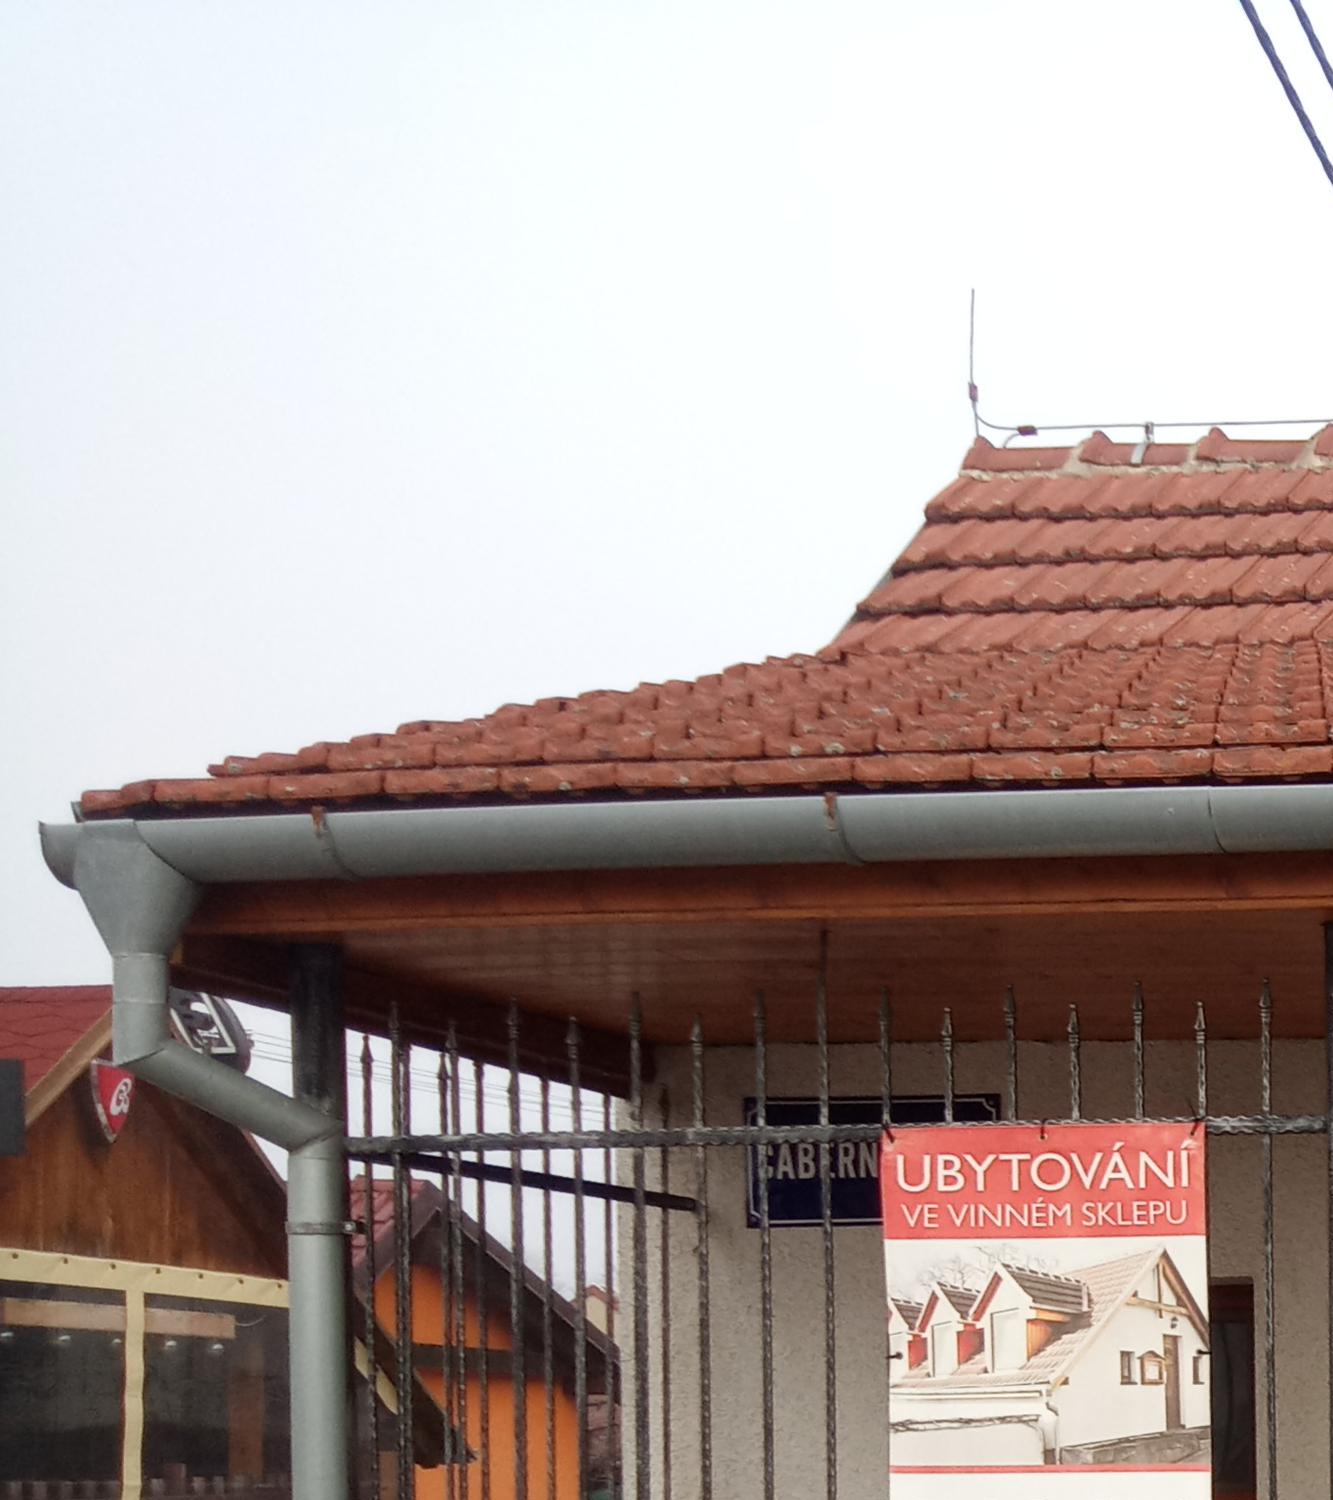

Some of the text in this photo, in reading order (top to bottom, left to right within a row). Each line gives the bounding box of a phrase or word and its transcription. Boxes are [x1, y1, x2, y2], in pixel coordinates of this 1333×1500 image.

[897, 1142, 1193, 1192] UBYTOVÁNÍ
[902, 1197, 1188, 1228] VE VINNÉM SKLEPU
